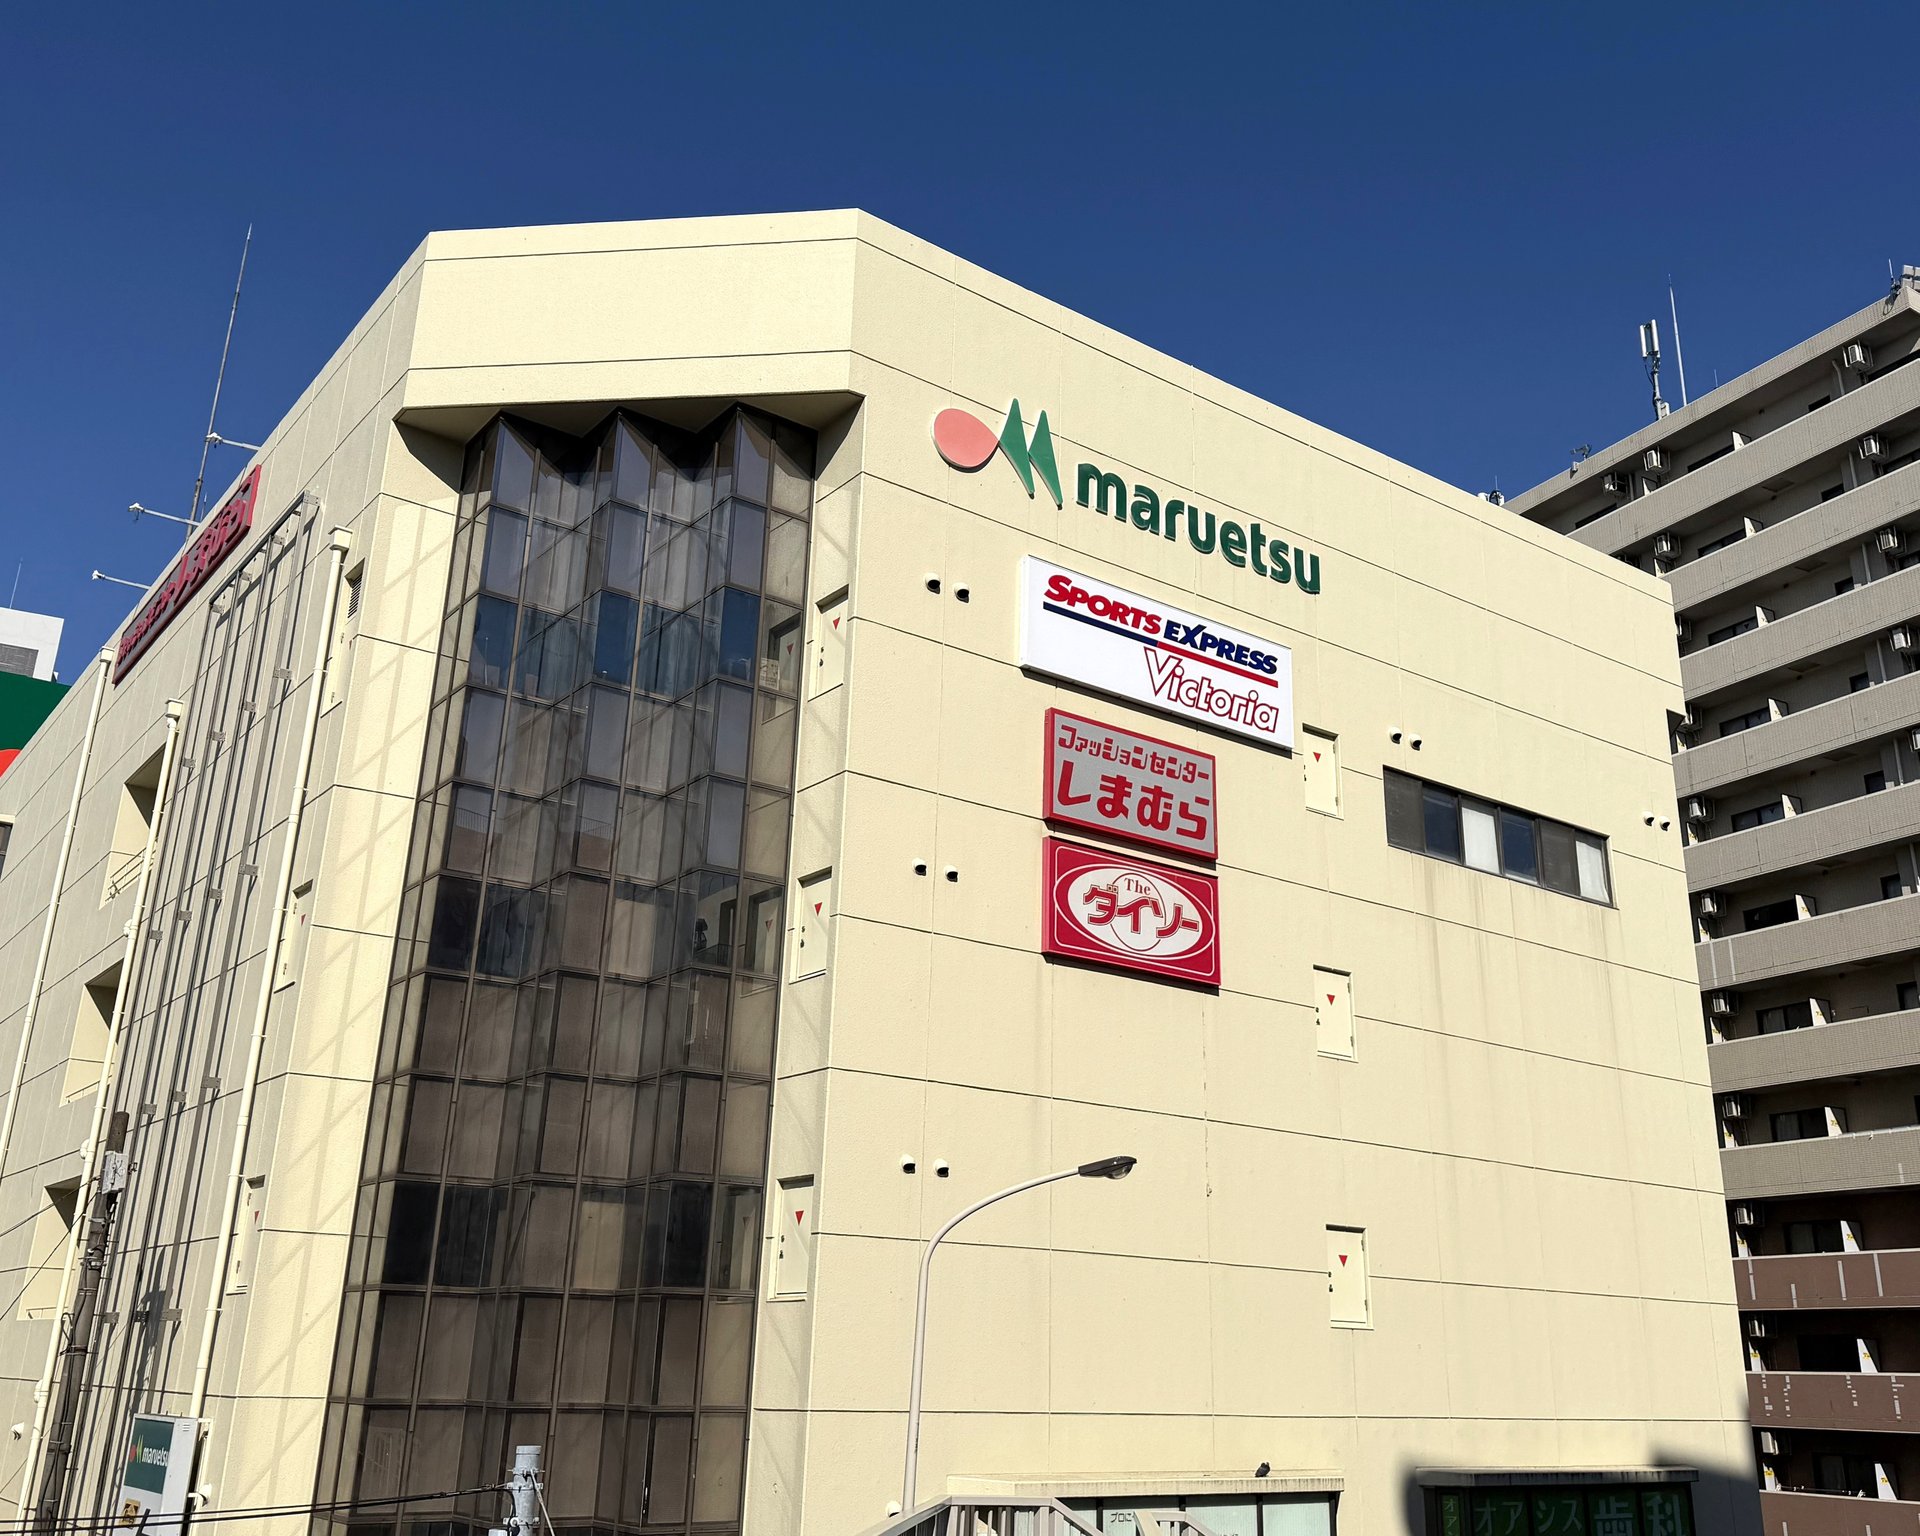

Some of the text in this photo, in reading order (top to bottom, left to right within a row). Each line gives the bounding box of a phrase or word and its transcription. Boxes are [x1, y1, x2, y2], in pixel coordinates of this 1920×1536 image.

[1075, 462, 1321, 595] maruetsu
[1044, 574, 1278, 675] SPORTS EXPRESS
[1143, 647, 1280, 733] Victoria
[1058, 724, 1209, 784] ファッションセンター
[1056, 760, 1210, 841] しまむら
[1082, 884, 1200, 938] ダイソー
[1124, 877, 1151, 896] The
[142, 1448, 169, 1467] maruetsu
